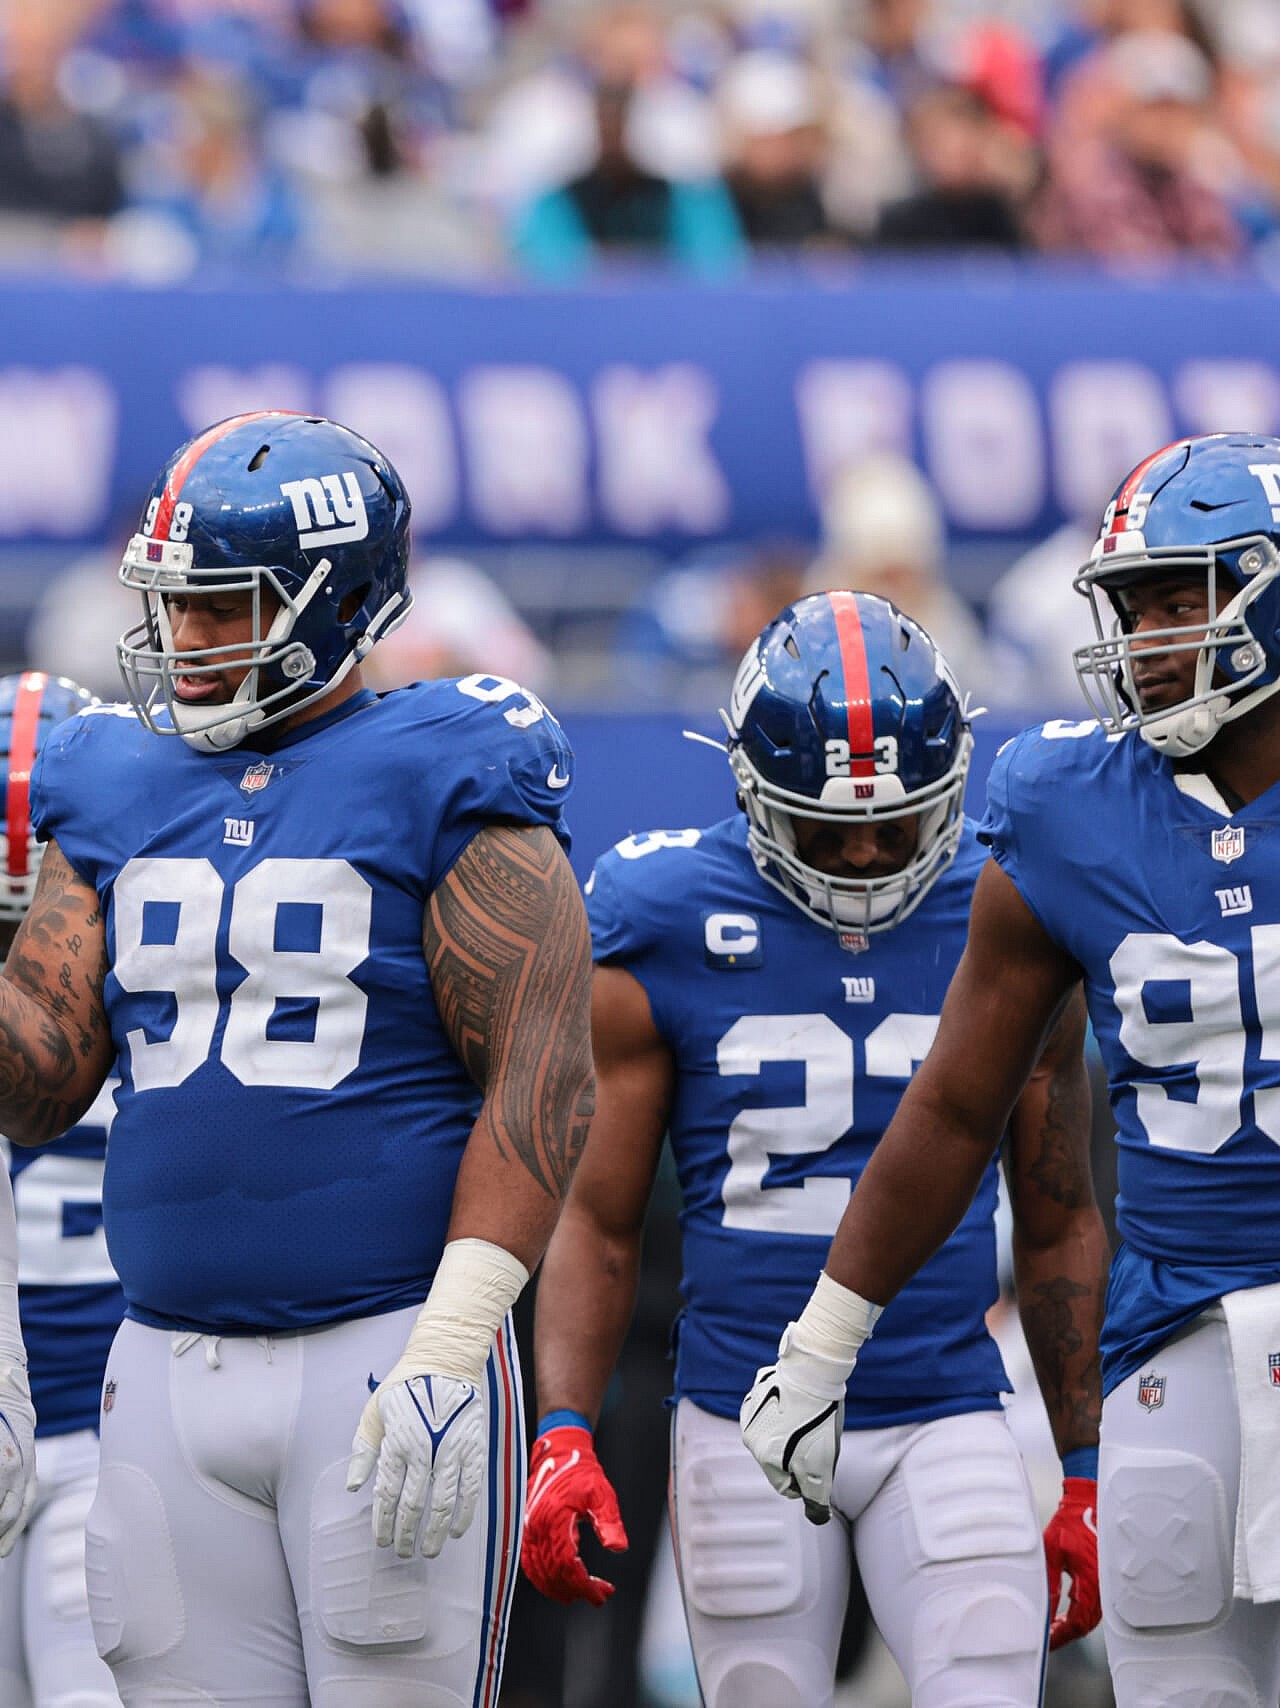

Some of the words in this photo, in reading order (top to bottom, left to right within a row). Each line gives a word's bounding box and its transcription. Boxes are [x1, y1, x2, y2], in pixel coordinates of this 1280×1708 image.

[143, 497, 194, 542] 98
[1100, 493, 1154, 537] 95
[825, 735, 898, 776] 23
[705, 914, 758, 955] C
[113, 857, 373, 1093] 98
[1109, 923, 1280, 1155] 9
